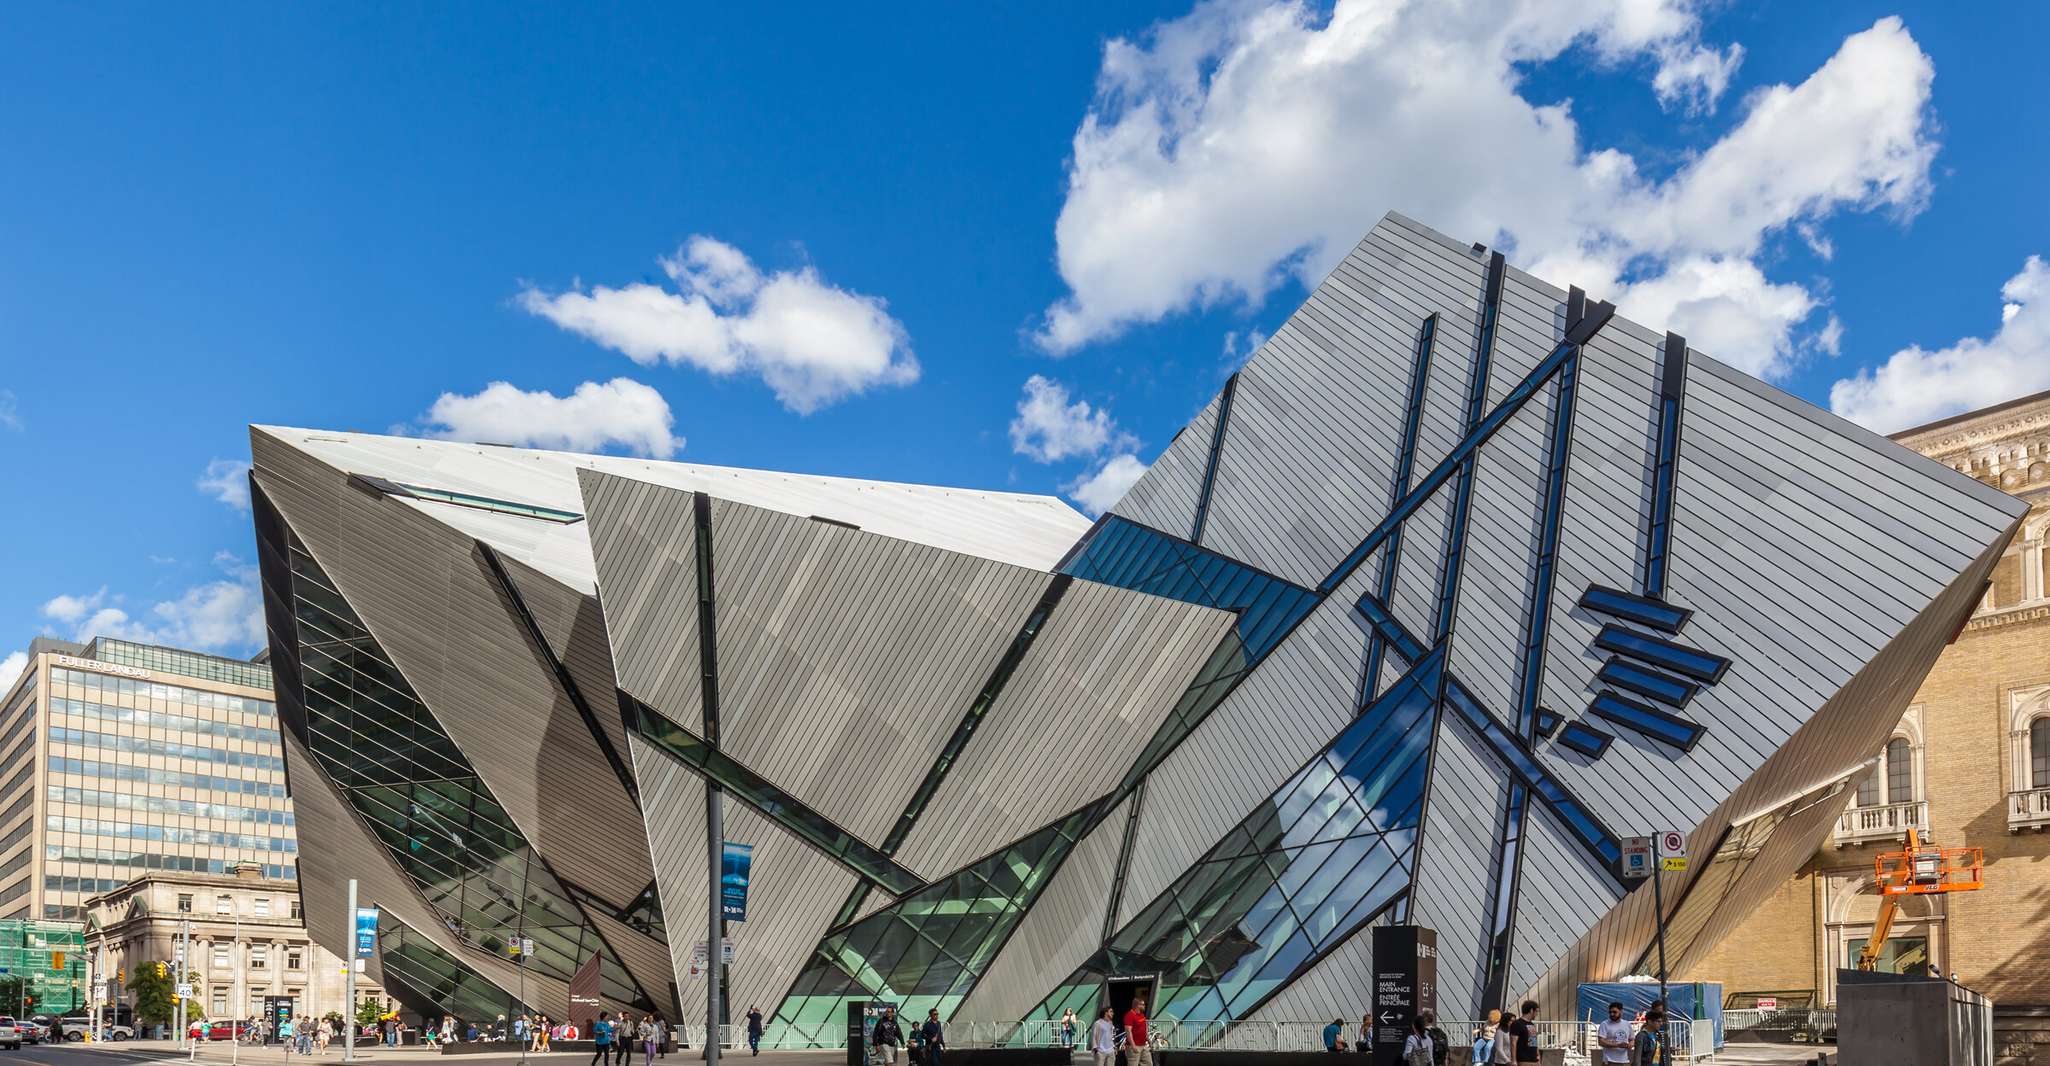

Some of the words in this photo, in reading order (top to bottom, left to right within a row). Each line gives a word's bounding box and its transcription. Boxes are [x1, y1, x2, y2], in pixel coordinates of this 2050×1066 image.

[59, 656, 103, 672] FULLER
[103, 662, 151, 680] LANDAU
[1624, 847, 1649, 855] STANDING
[179, 989, 192, 997] 40
